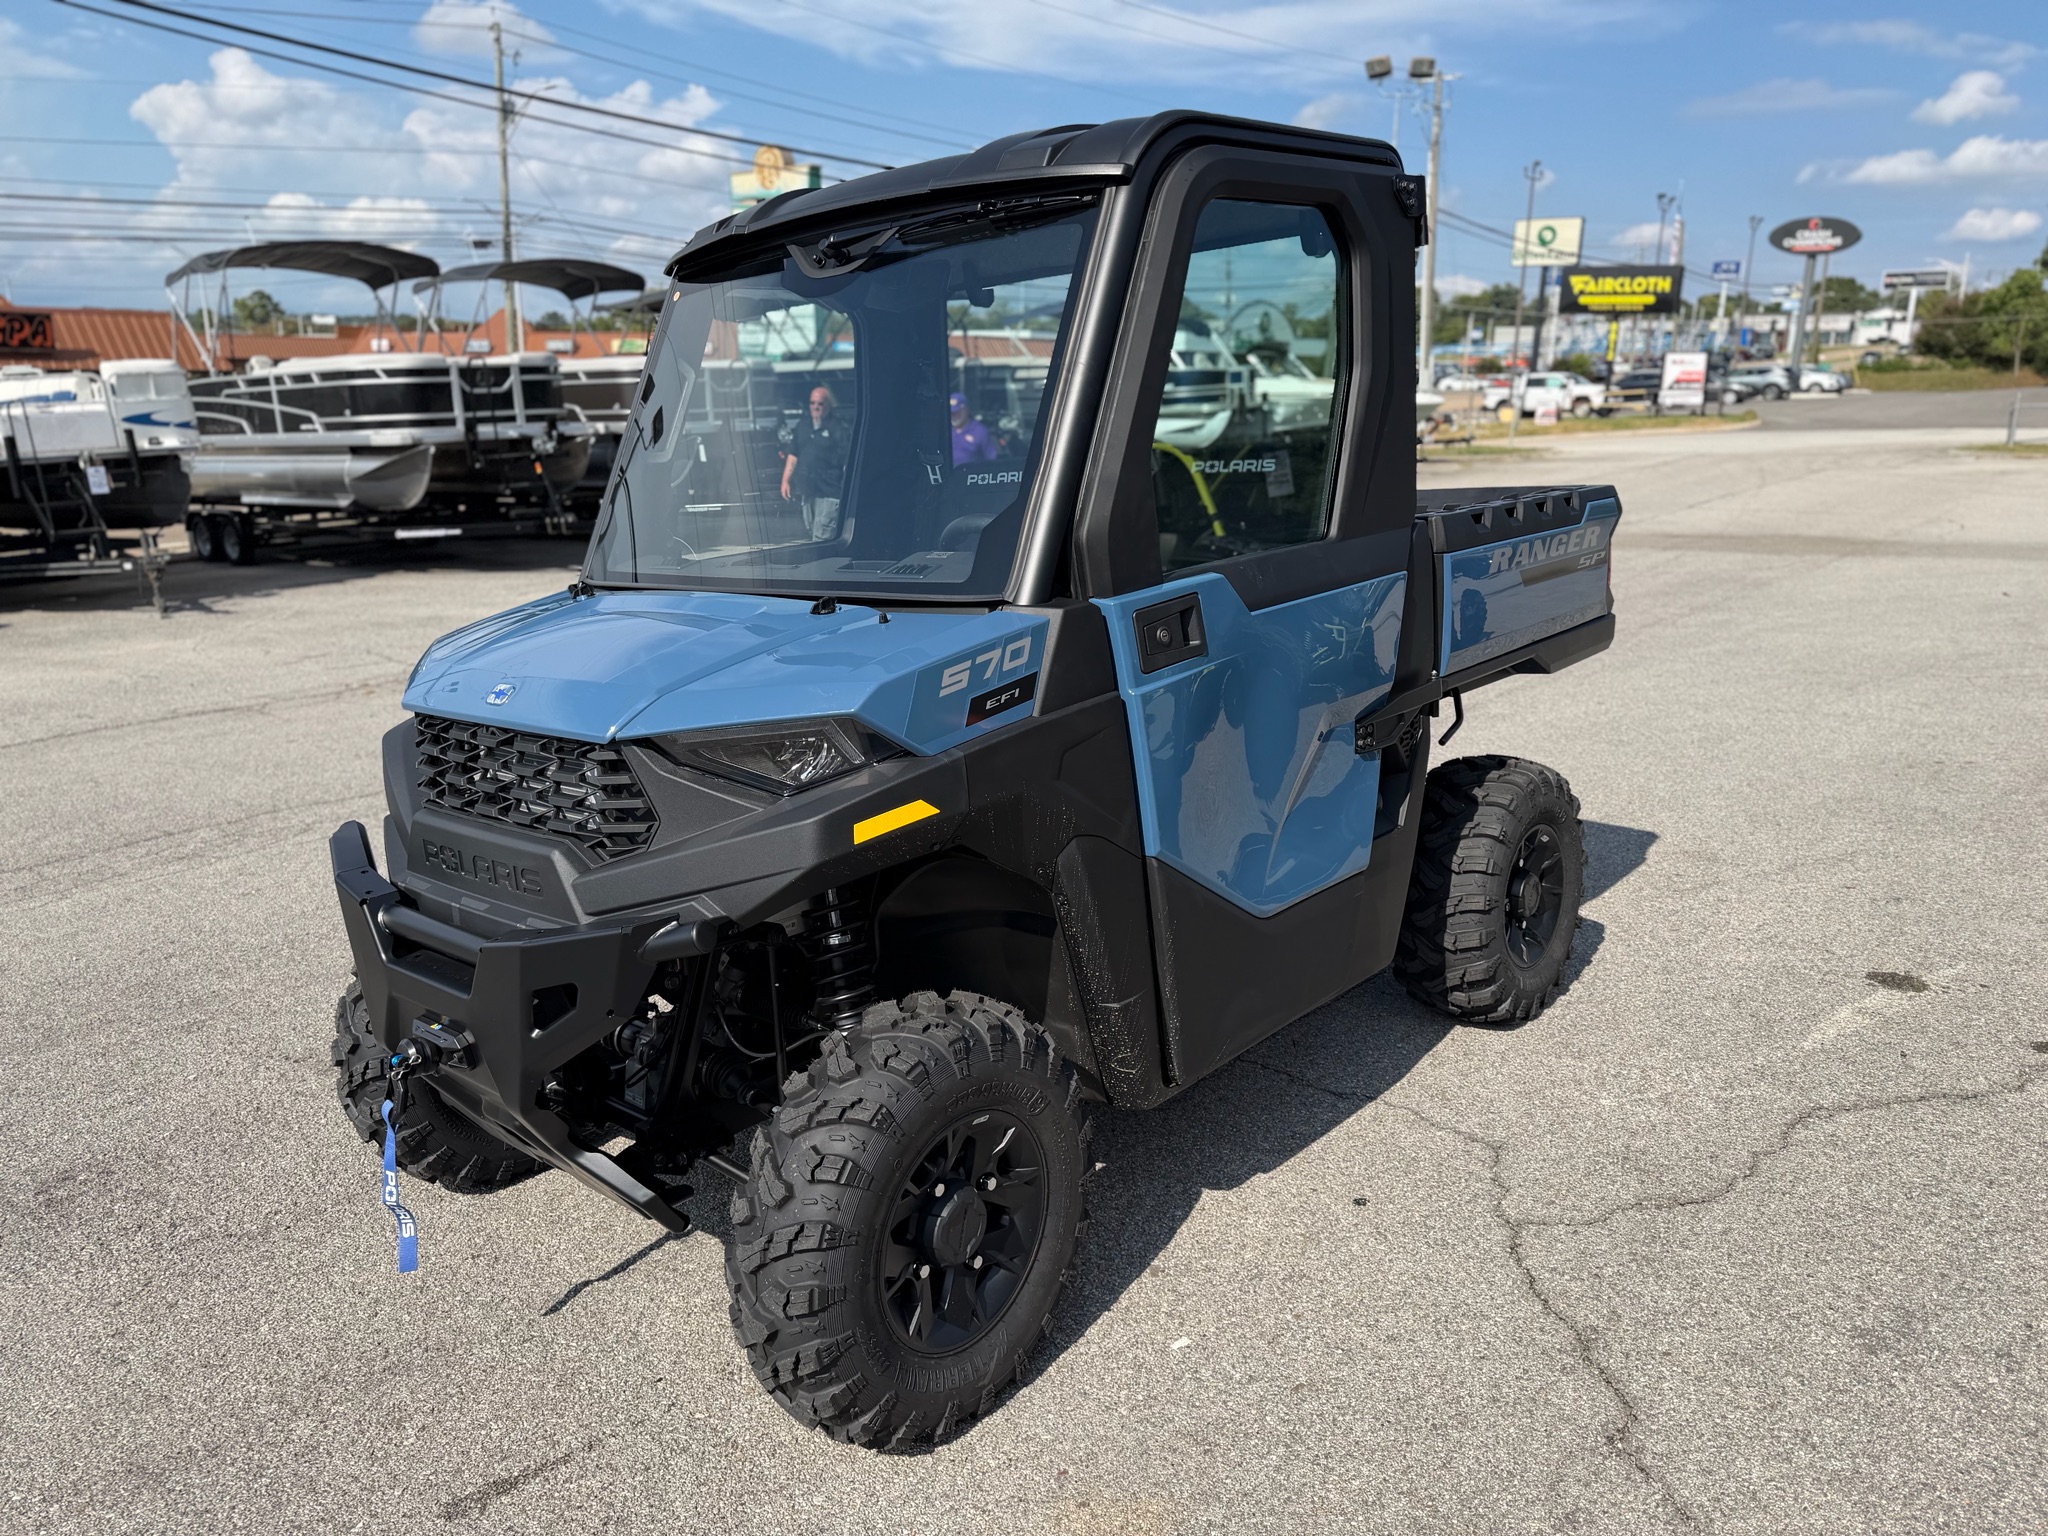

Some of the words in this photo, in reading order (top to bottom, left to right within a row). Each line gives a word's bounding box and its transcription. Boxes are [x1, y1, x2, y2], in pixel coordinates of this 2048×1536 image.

[1569, 275, 1672, 295] FAIRCLOTH
[0, 315, 53, 347] PA
[1190, 459, 1276, 474] POLARIS
[966, 471, 1023, 485] POLARI
[1488, 525, 1601, 574] RANGER
[1577, 551, 1606, 569] SP
[939, 636, 1032, 698] 570
[986, 688, 1020, 710] EFI
[423, 839, 543, 899] POLARIS
